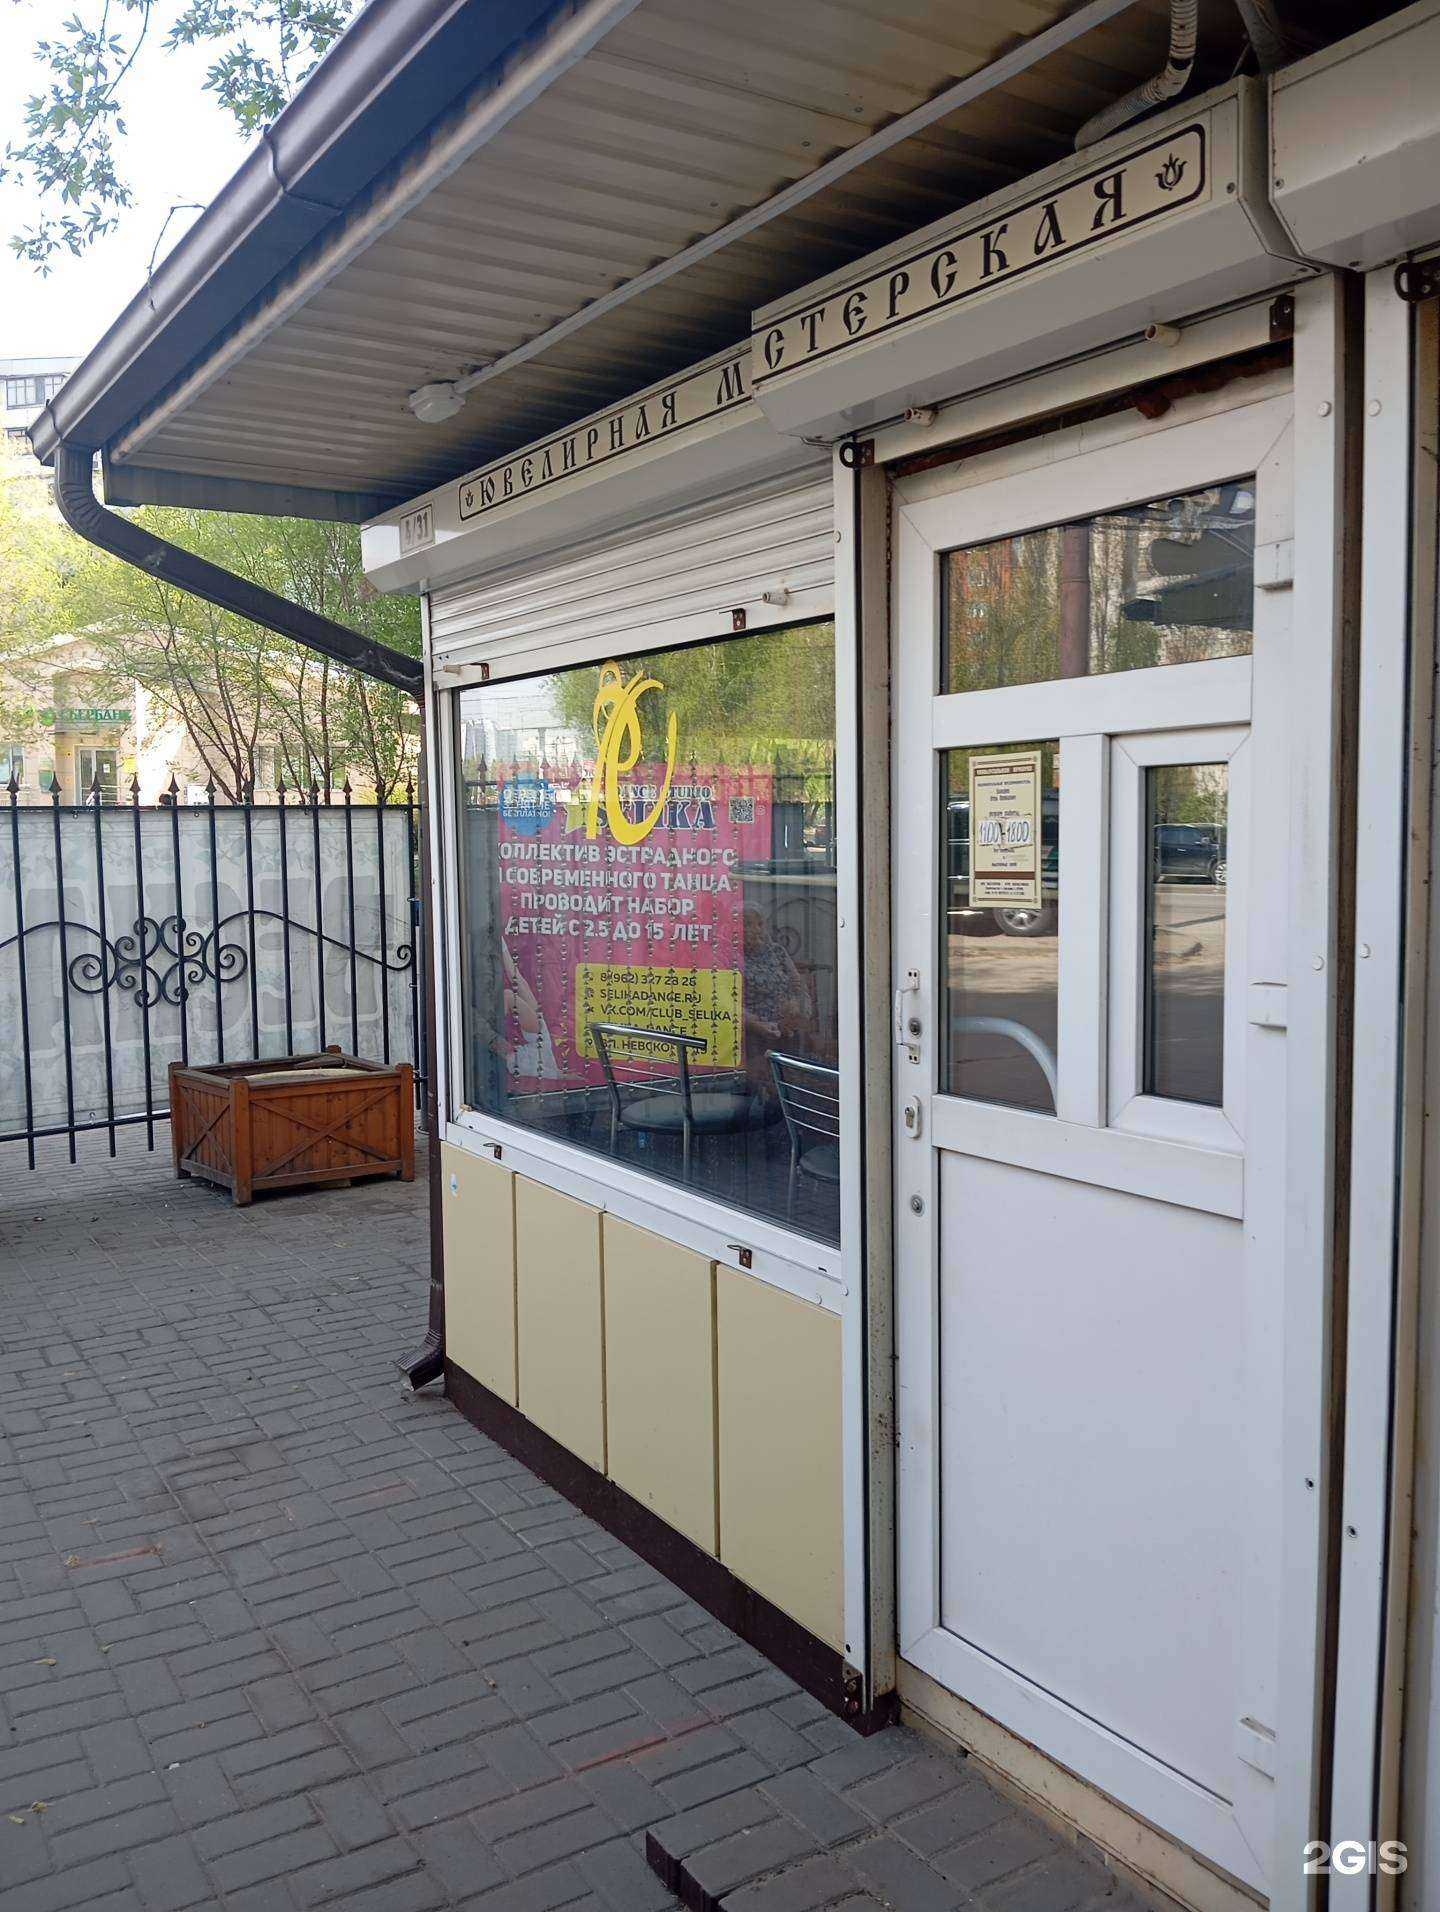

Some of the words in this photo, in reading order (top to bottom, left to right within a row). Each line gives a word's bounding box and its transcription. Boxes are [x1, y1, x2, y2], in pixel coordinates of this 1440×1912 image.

[480, 391, 678, 507] ЮВЕЛИРНАЯ
[717, 169, 1127, 405] МСТЕРСКАЯ
[498, 842, 600, 862] ОЛЛЕКТИВ
[506, 866, 657, 890] СОВРЕМЕННОГО
[660, 872, 732, 893] ТАНЦА
[521, 892, 624, 915] ПРОВОДИТ
[627, 896, 694, 915] НАБОР
[505, 913, 566, 936] ДЕТЕЙ
[569, 920, 580, 936] С
[584, 920, 609, 938] 2.5
[613, 921, 641, 941] ДО
[645, 922, 665, 940] 15
[670, 924, 713, 942] ЛЕТ
